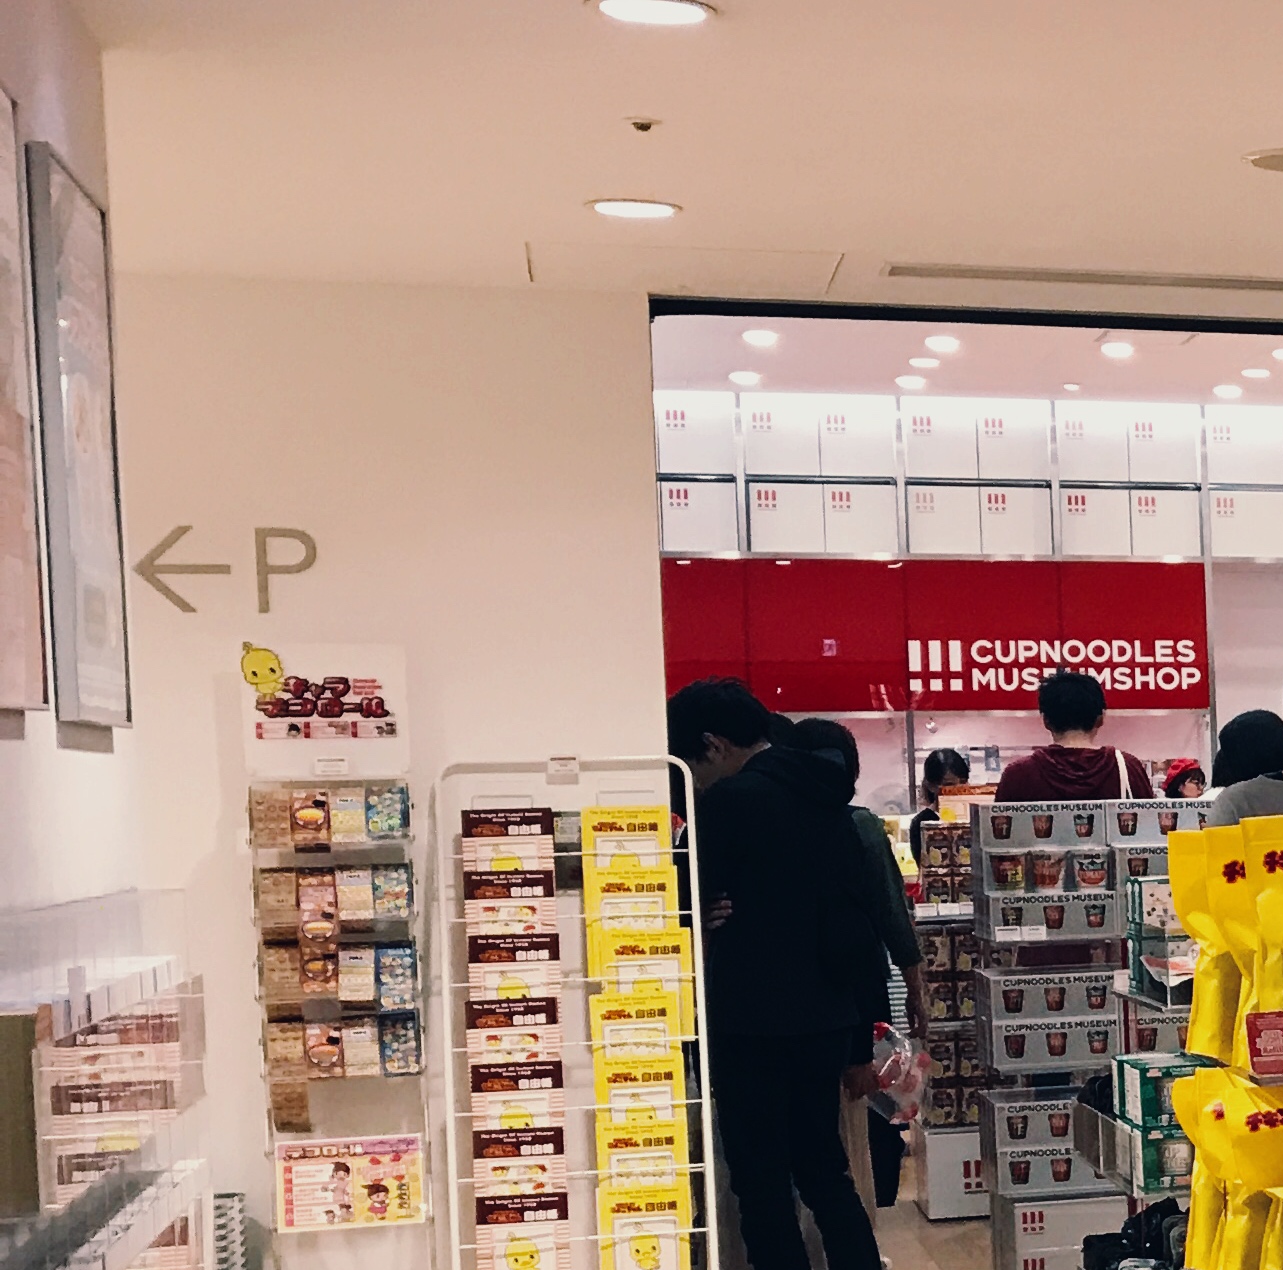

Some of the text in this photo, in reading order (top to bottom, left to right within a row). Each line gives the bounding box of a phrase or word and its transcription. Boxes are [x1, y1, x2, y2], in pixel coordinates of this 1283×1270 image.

[254, 526, 319, 614] P
[970, 638, 1197, 664] CUPNOODLES
[970, 666, 1202, 692] MUSMSHOP
[1186, 801, 1213, 809] MUSE
[1009, 1148, 1072, 1159] CUPNOODLE
